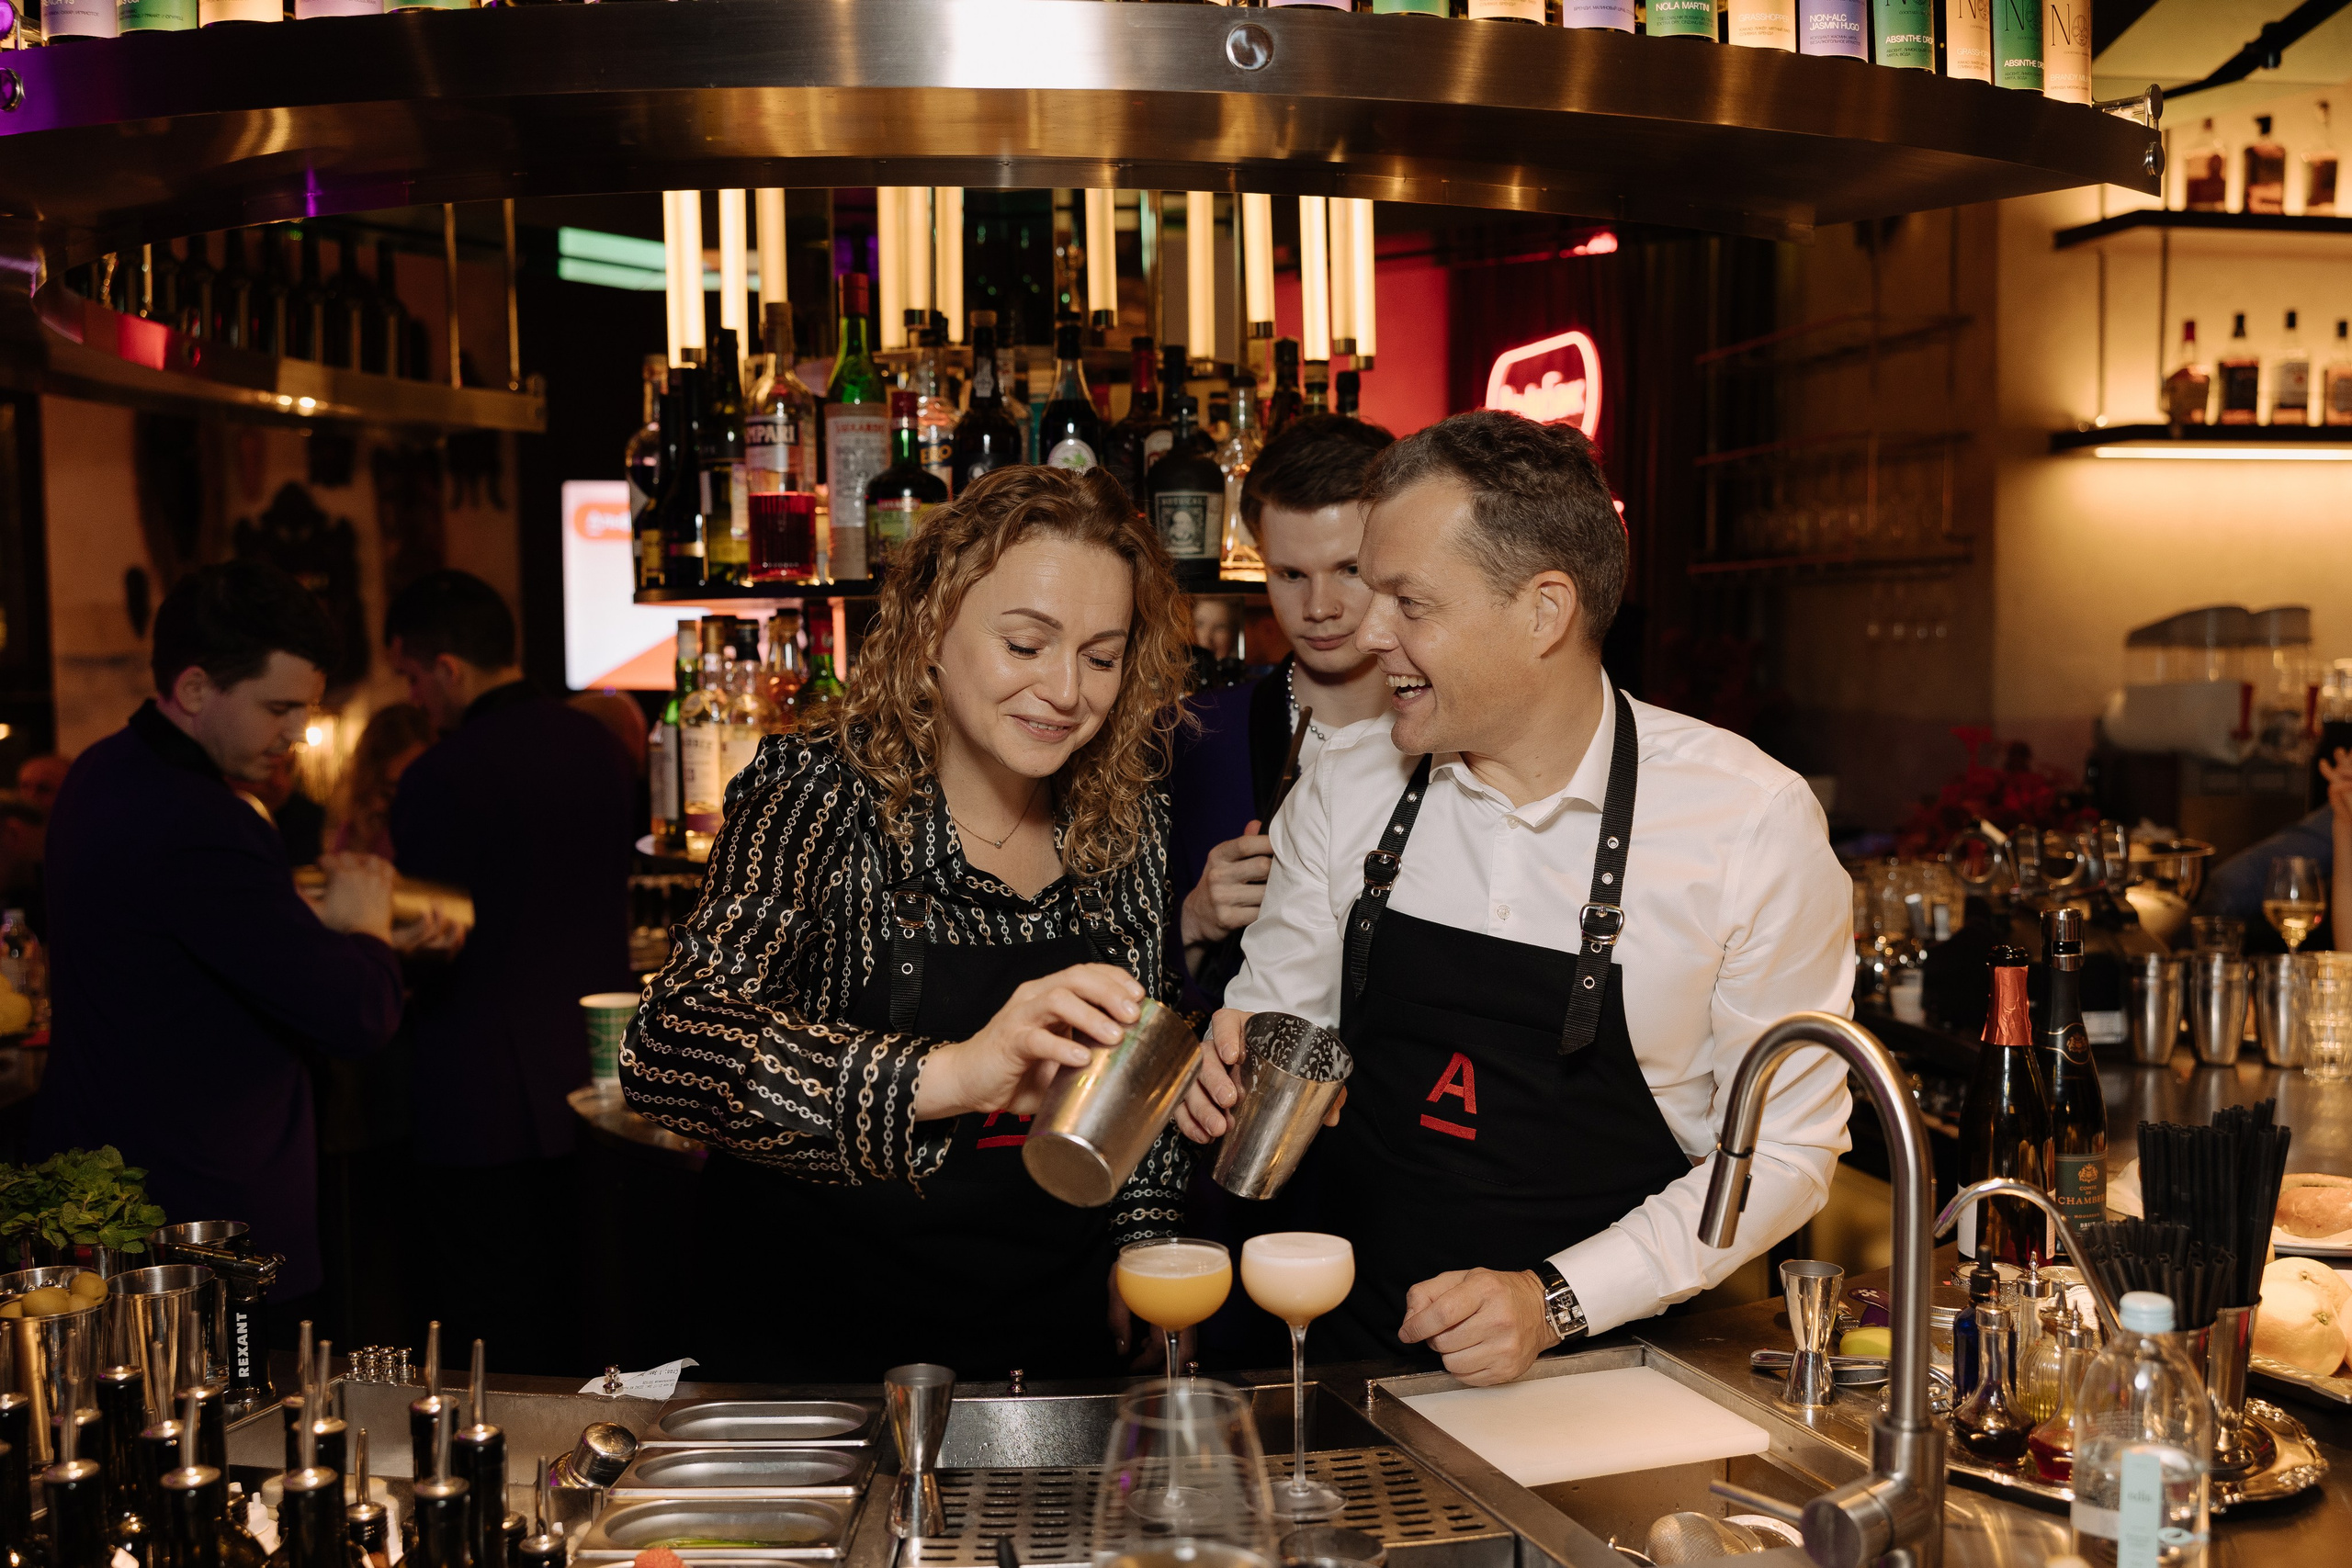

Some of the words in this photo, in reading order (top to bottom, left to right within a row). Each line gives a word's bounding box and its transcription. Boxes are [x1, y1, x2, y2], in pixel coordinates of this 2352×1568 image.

[1656, 2, 1680, 12] NOLA
[1738, 13, 1790, 24] GRASSHOPPER
[1809, 14, 1848, 23] NON-ALC
[1809, 21, 1839, 31] JASMIN
[1840, 22, 1860, 32] HUGO
[1885, 34, 1922, 44] ABSINTHE
[2004, 59, 2037, 68] ABSINTHE
[2050, 73, 2078, 82] BRANDY
[746, 423, 797, 445] MPARI
[1425, 1052, 1477, 1115] A
[235, 1312, 250, 1378] REXANT
